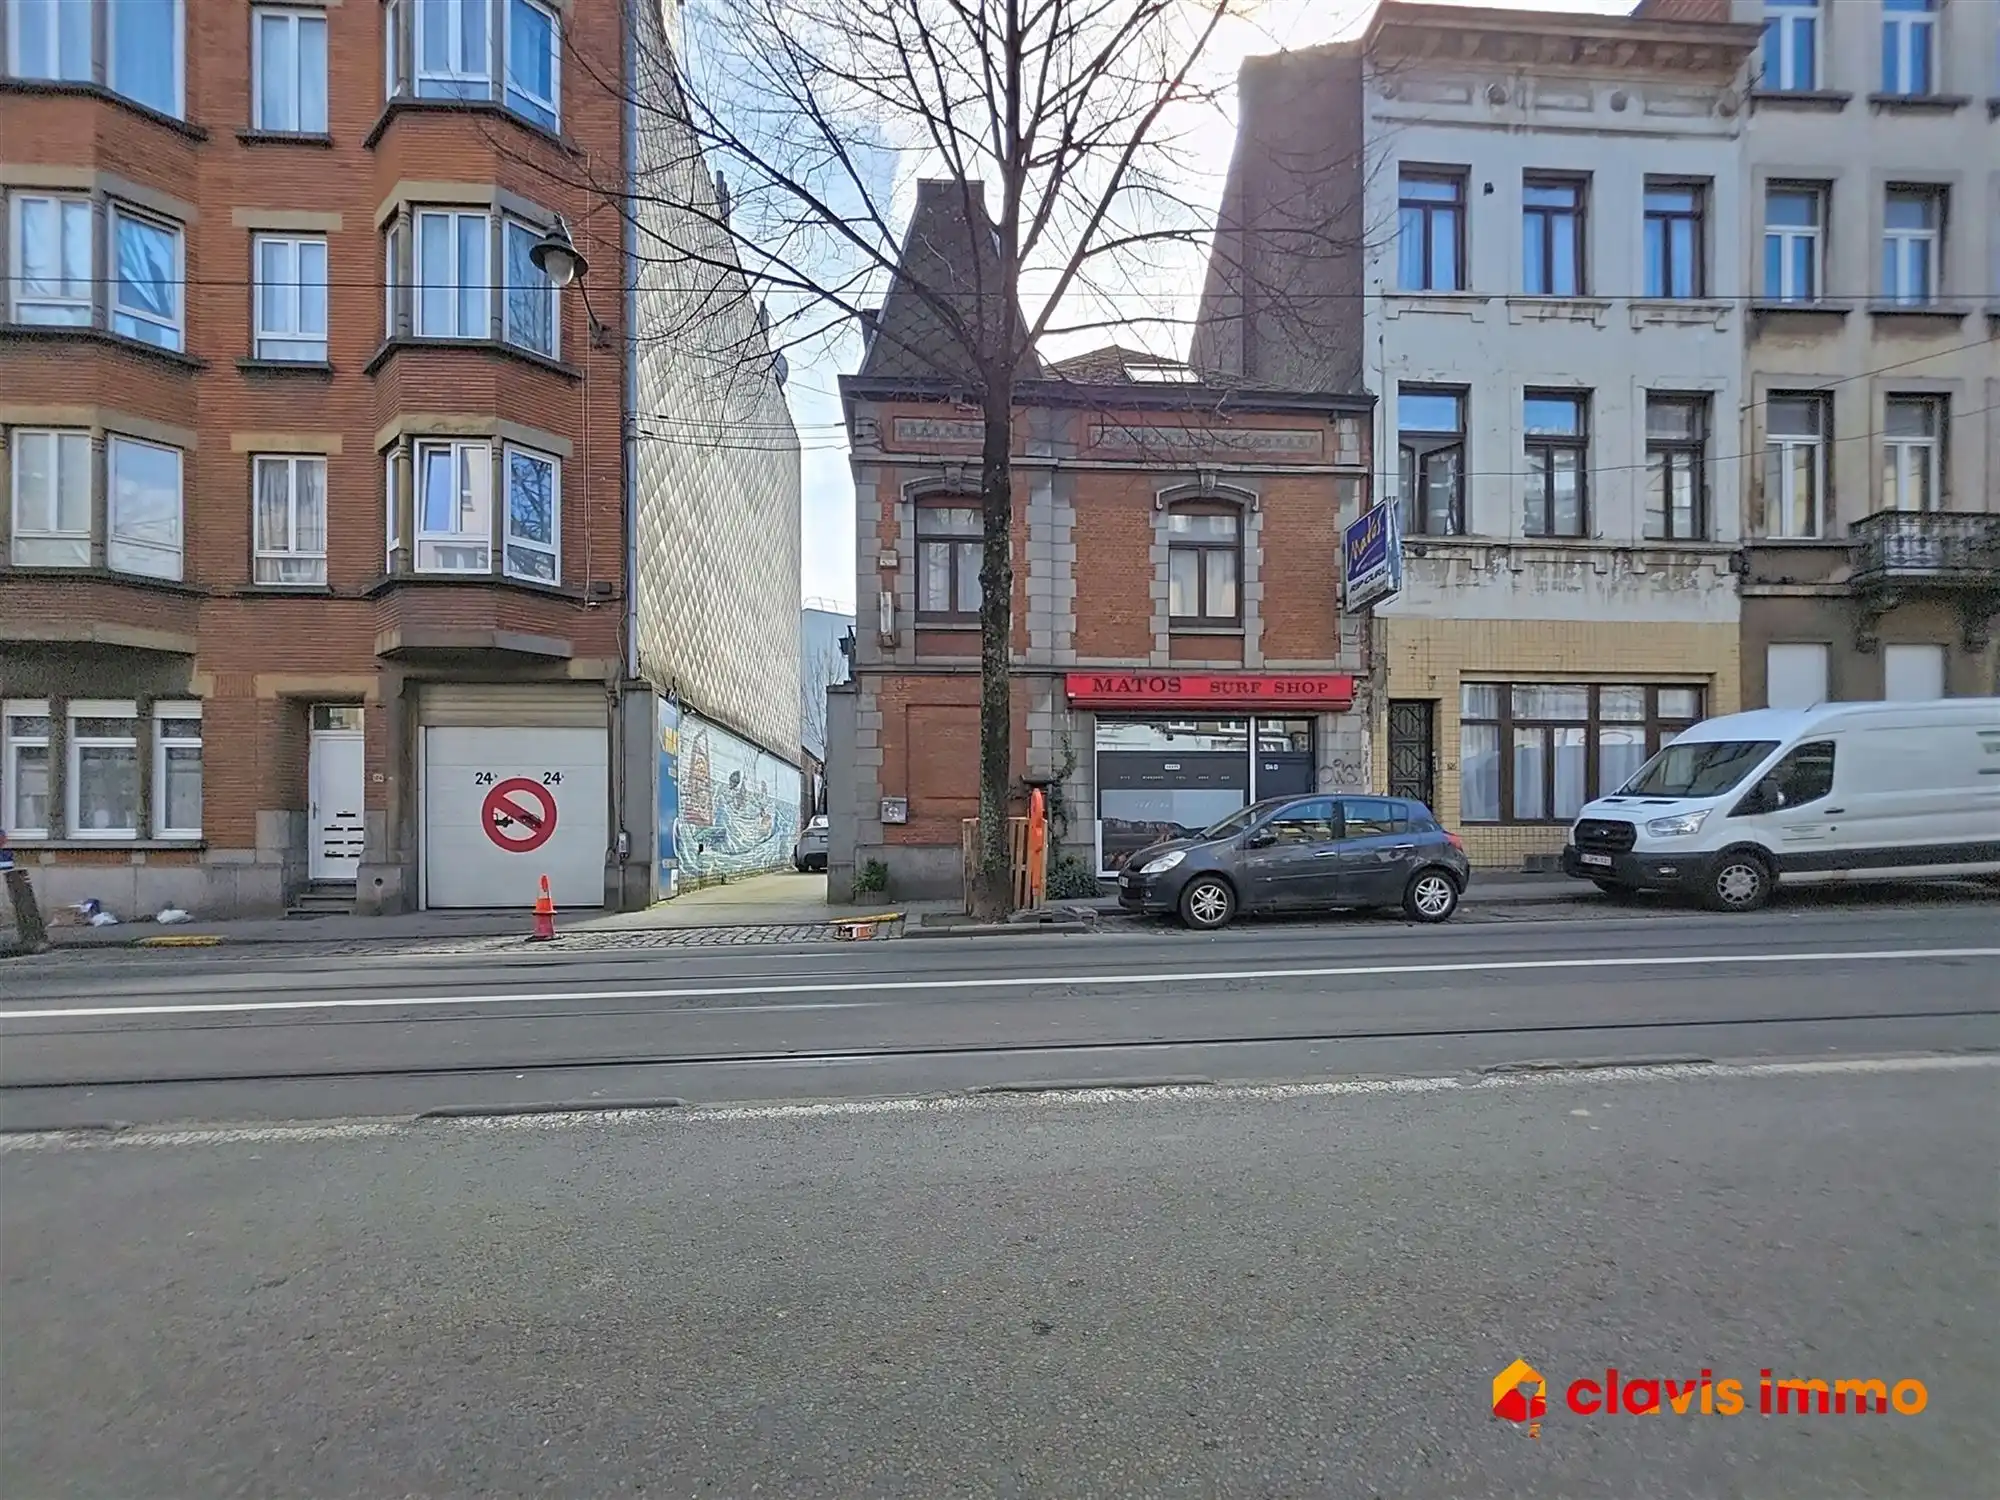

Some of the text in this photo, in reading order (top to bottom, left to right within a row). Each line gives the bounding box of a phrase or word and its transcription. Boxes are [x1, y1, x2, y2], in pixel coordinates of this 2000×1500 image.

[1364, 566, 1387, 585] CURL
[1092, 676, 1329, 694] MATOS SURF SHOP
